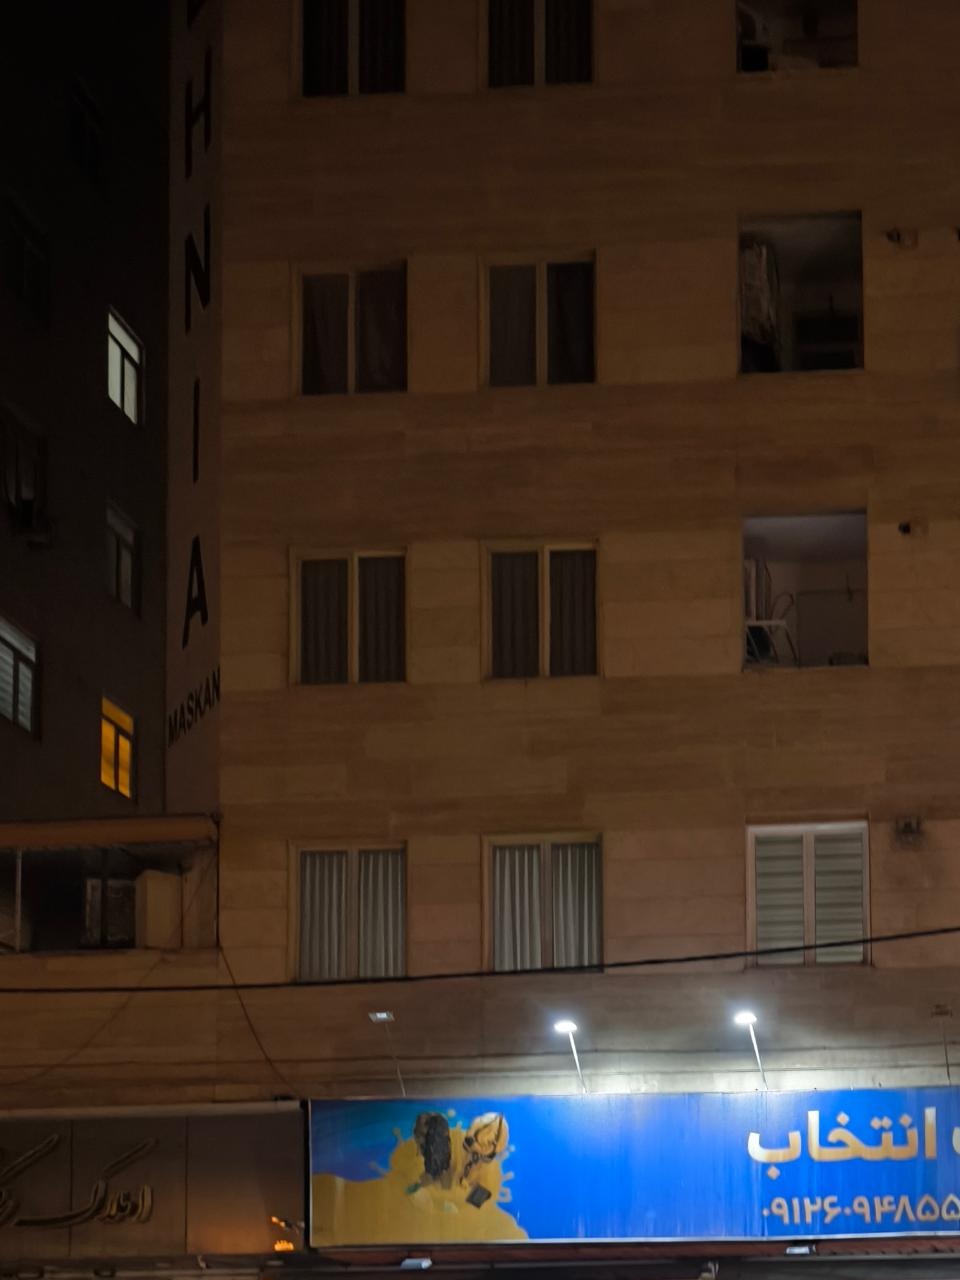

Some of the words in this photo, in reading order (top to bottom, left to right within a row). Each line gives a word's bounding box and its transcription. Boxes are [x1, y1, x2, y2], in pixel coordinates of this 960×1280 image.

[182, 0, 213, 650] HNIA
[167, 665, 221, 748] MASKAN
[747, 1106, 936, 1180] انتخاب
